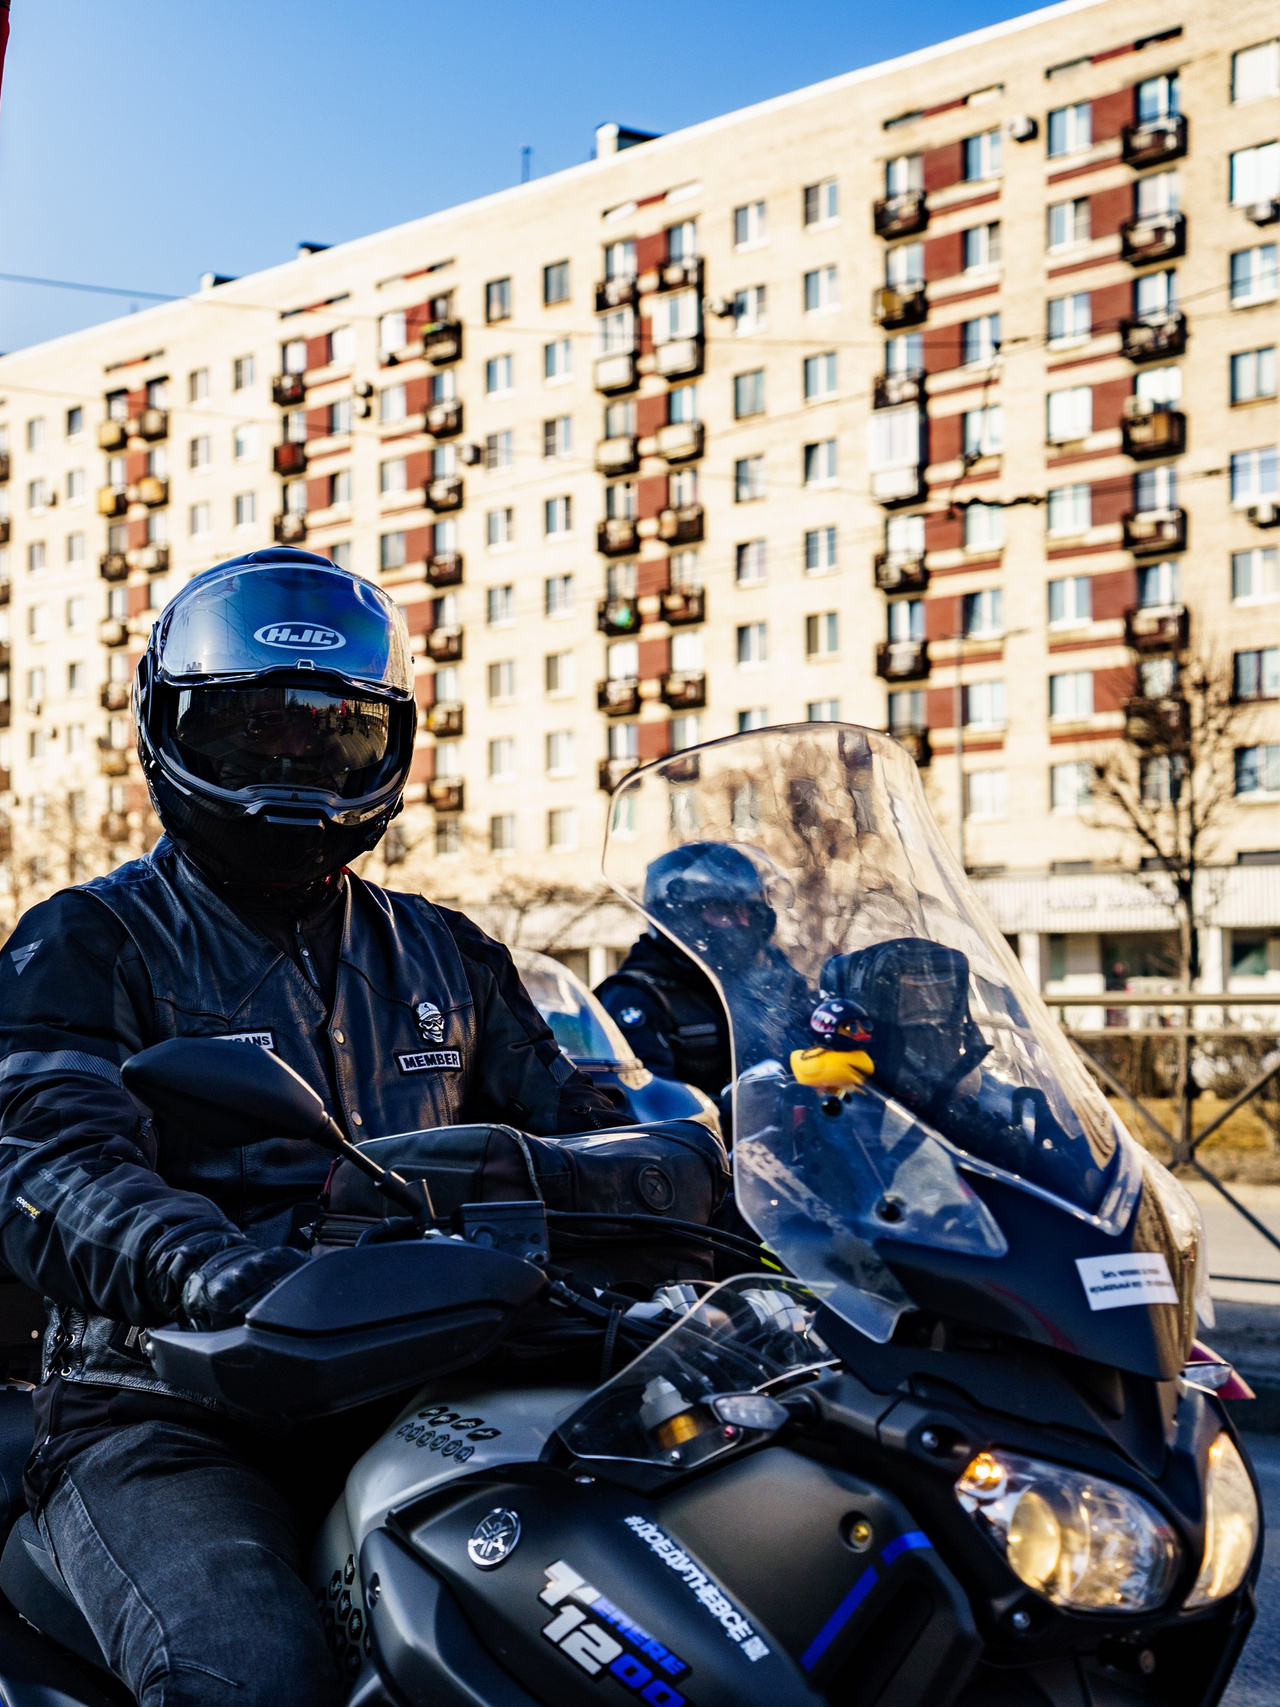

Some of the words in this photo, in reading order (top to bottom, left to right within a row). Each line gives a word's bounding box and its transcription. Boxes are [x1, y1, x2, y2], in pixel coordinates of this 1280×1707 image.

[266, 628, 335, 645] HJC
[402, 1050, 459, 1070] MEMBER
[624, 1515, 754, 1642] #ДОЕДУТНЕВСЕ
[542, 1604, 687, 1707] 1200
